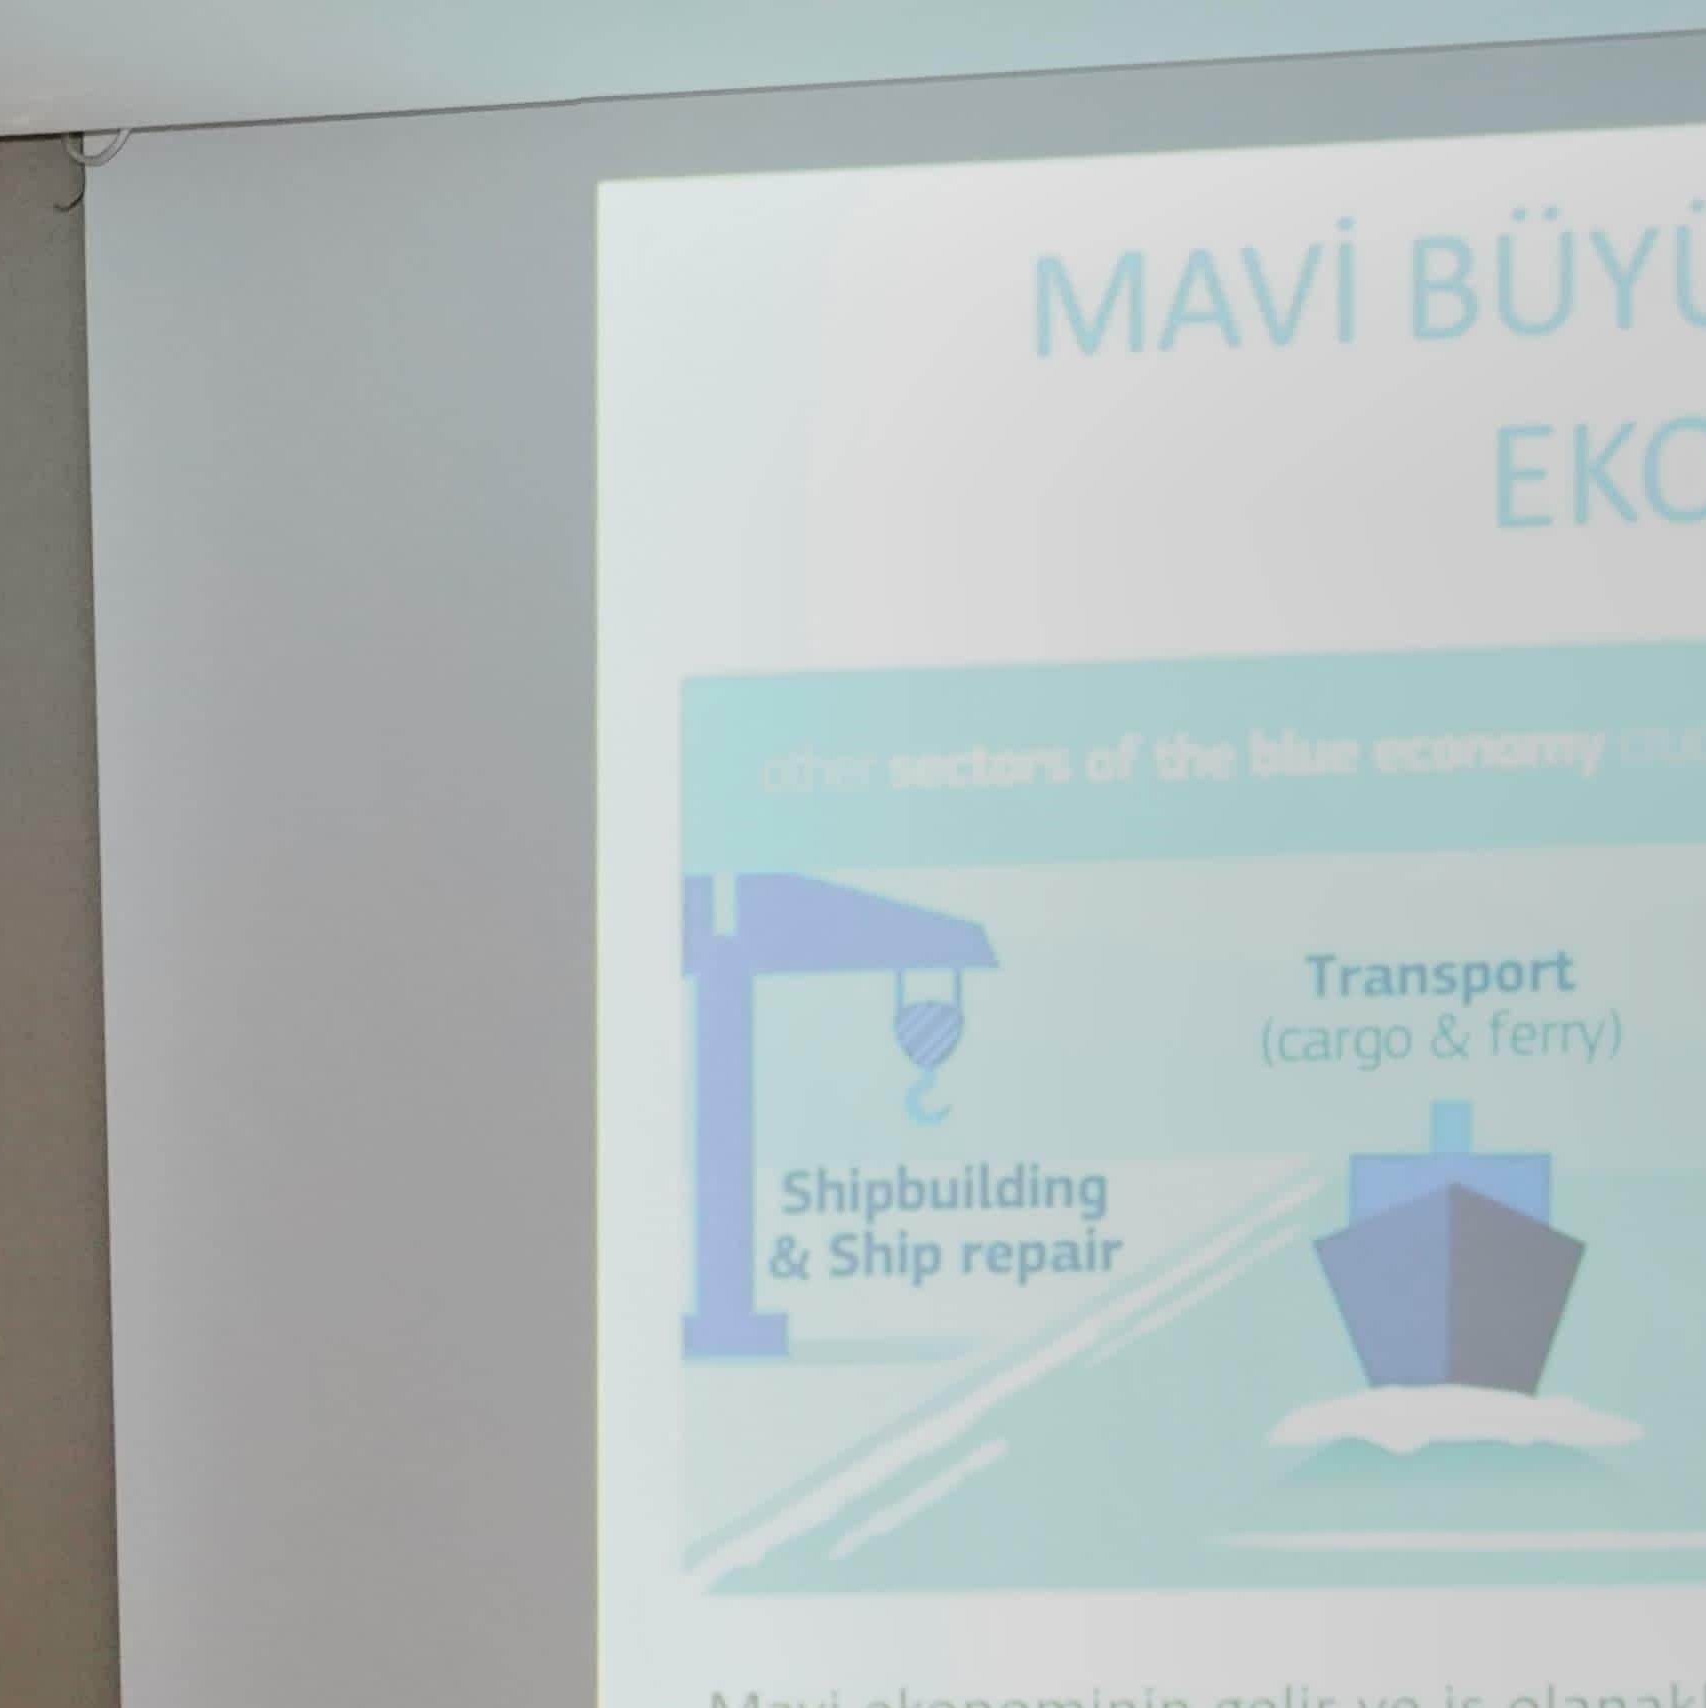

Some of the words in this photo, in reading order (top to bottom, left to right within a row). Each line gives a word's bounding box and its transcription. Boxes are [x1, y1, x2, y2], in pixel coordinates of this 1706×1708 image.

[1034, 216, 1356, 359] MAVİ
[889, 744, 1074, 788] sectors
[1085, 730, 1142, 784] of
[1152, 728, 1237, 780] the
[1247, 728, 1359, 778] blue
[1371, 730, 1607, 782] economy
[1305, 949, 1577, 1007] Transport
[1260, 1018, 1414, 1072] (cargo
[1429, 1011, 1470, 1060] &
[1487, 1007, 1624, 1065] ferry)
[781, 1160, 1108, 1222] Shipbuilding
[767, 1233, 810, 1281] &
[829, 1227, 943, 1288] Ship
[962, 1225, 1124, 1287] repair
